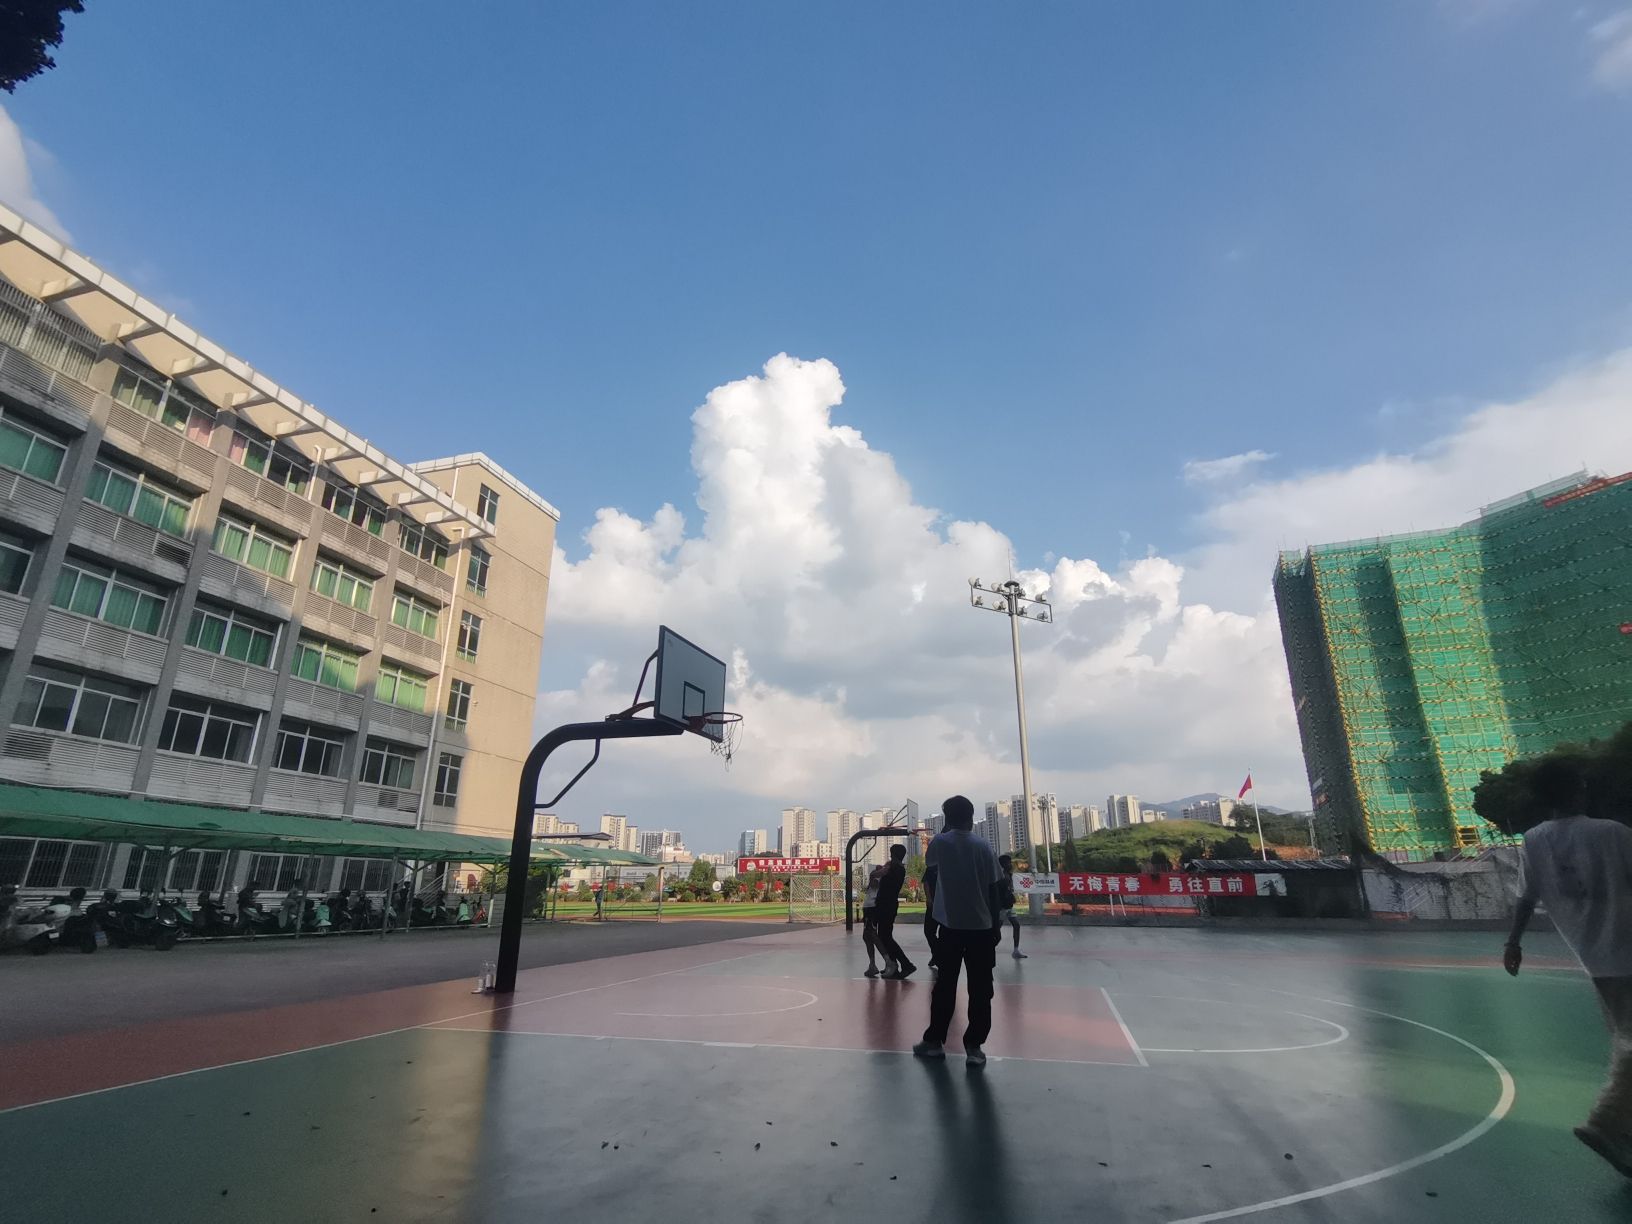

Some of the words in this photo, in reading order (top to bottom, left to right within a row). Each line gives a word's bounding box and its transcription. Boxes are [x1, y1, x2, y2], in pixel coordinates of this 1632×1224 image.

[1069, 876, 1140, 892] 无悔青春
[1168, 876, 1243, 892] 勇往直前
